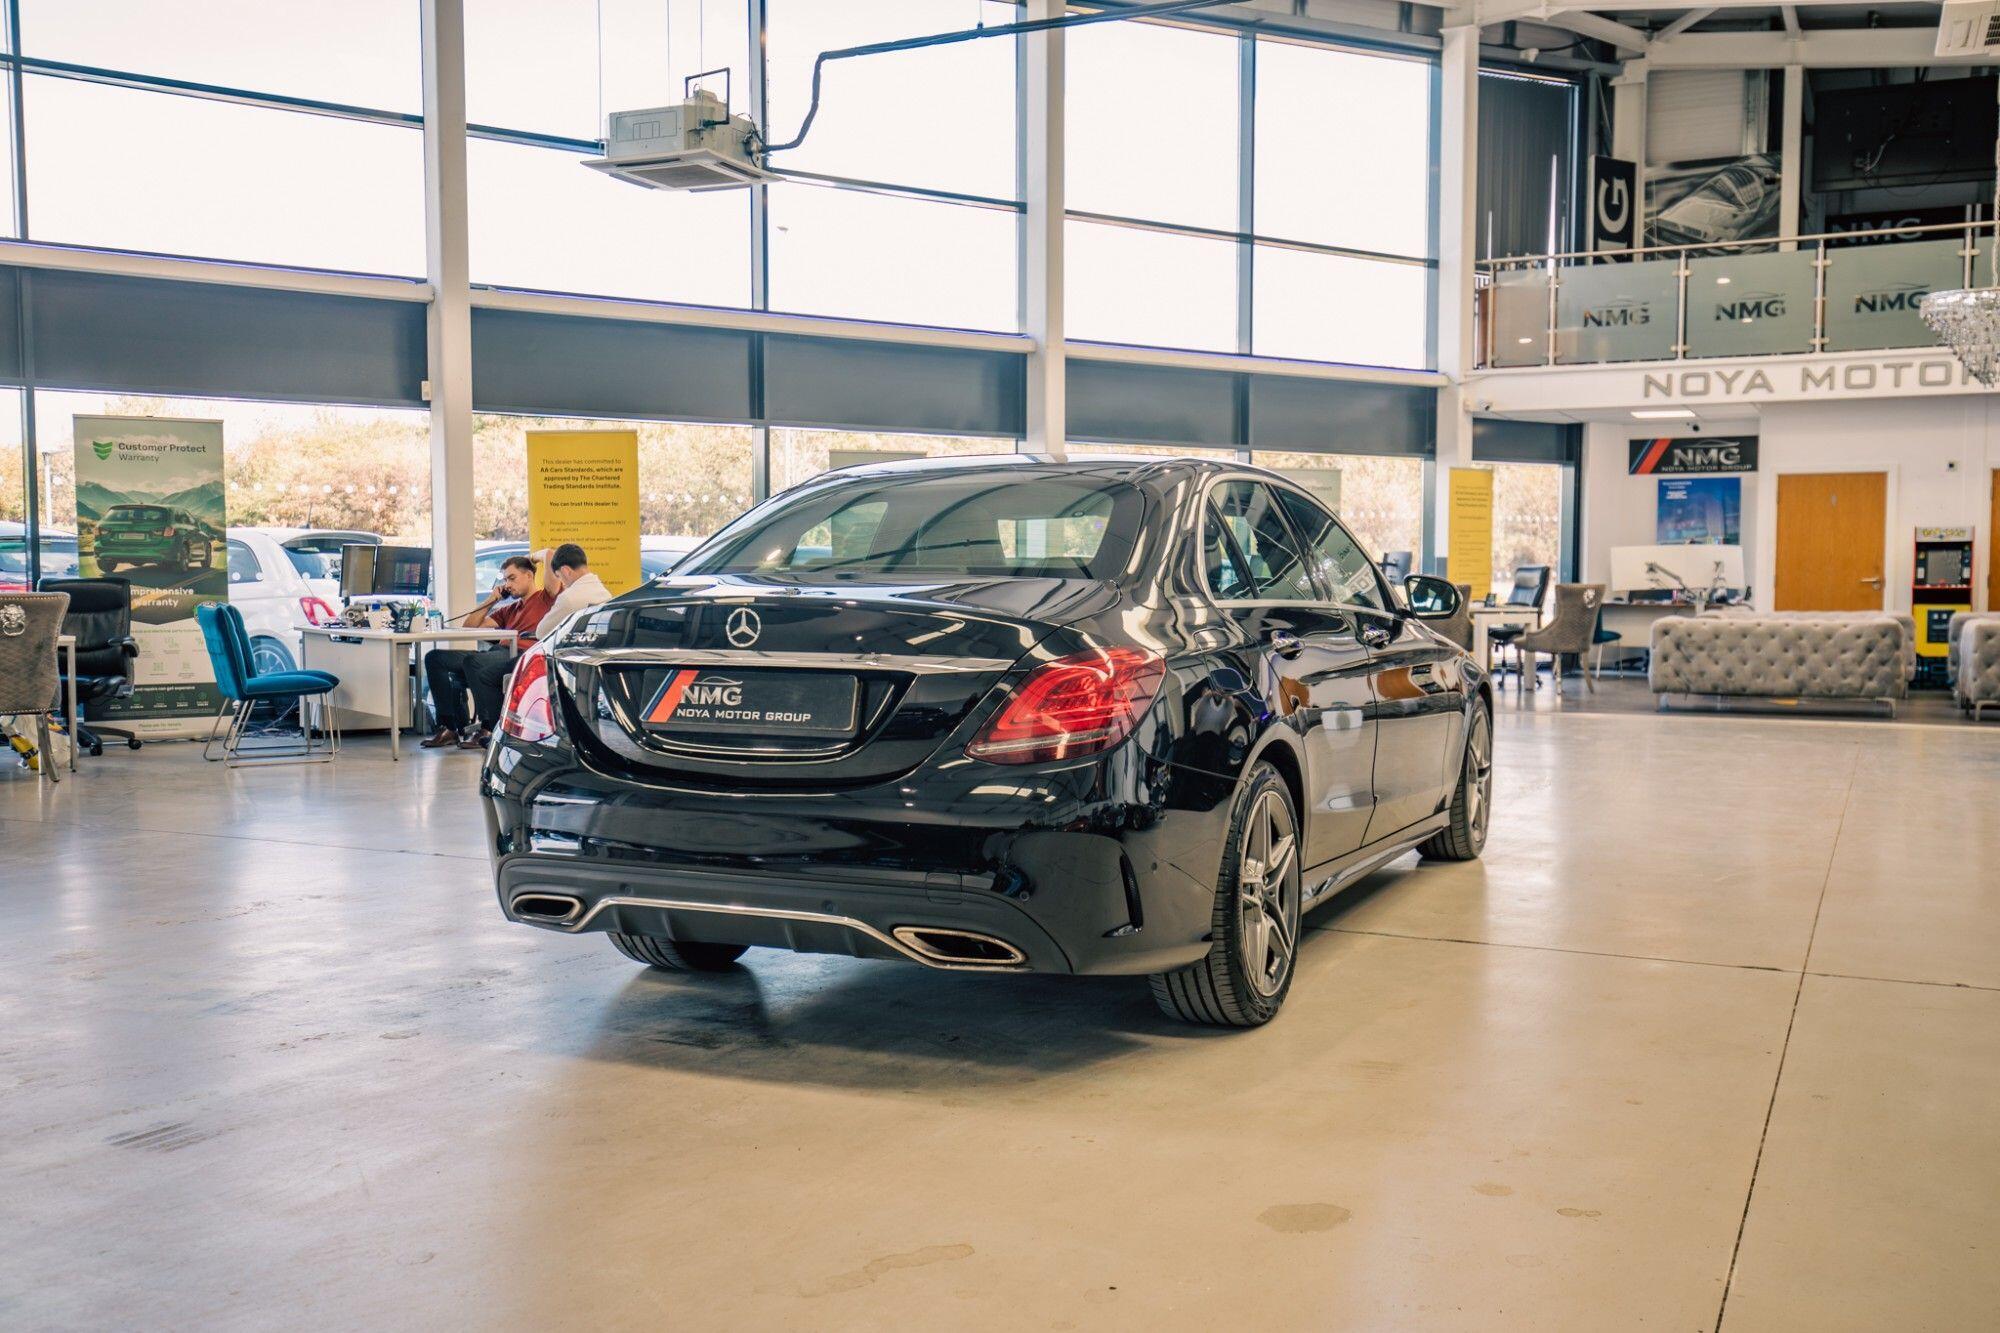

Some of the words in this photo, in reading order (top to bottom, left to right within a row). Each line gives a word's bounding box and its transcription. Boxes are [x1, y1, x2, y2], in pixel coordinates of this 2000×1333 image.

[1583, 306, 1650, 328] NMG
[1715, 300, 1787, 321] NMG
[1644, 369, 1775, 398] NOYA
[118, 442, 167, 451] Customer
[169, 444, 206, 453] Protect
[1673, 447, 1741, 466] NMG
[119, 453, 159, 463] Warranty
[680, 685, 742, 706] NMG
[677, 708, 710, 718] NOYA
[715, 710, 761, 720] MOTOR
[765, 712, 811, 722] GROUP
